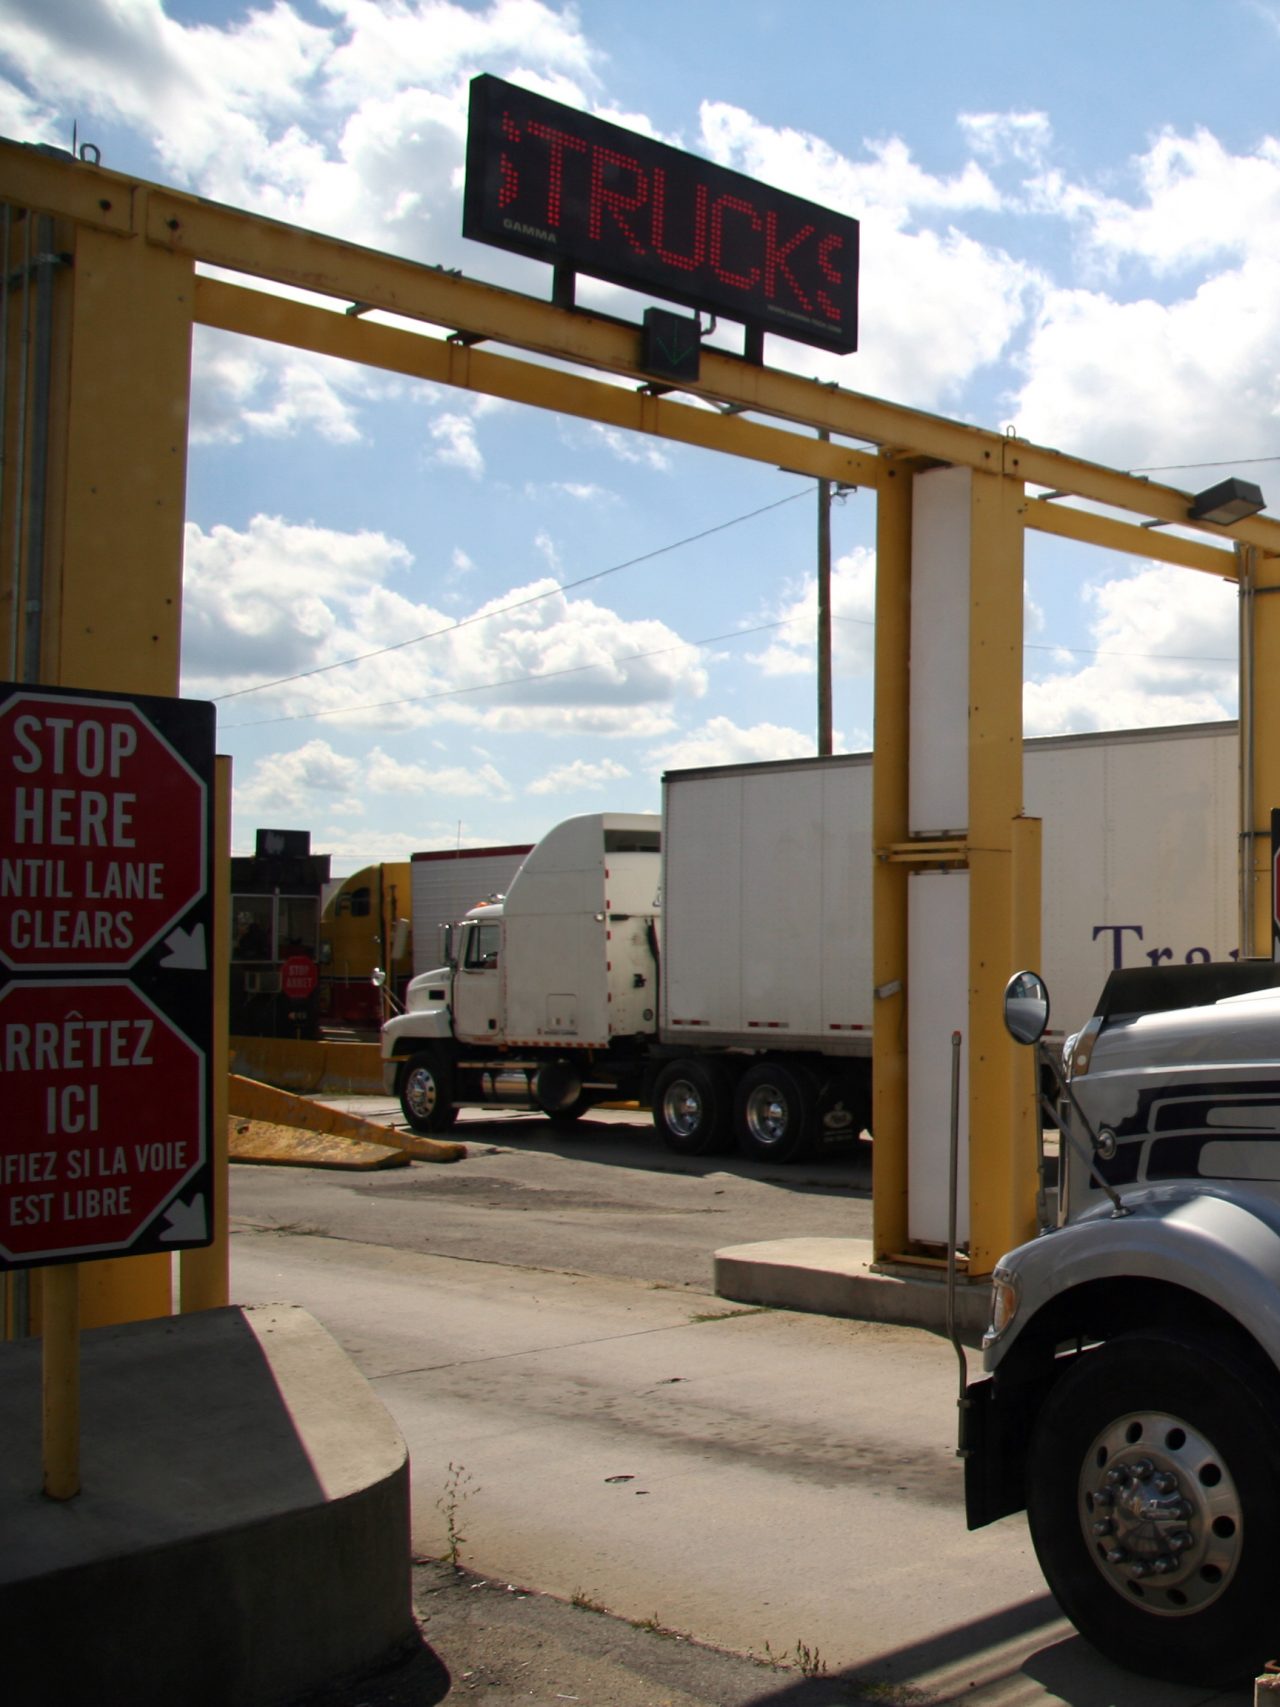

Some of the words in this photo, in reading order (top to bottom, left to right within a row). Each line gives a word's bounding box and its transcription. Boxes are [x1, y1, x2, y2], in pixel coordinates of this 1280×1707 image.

[503, 218, 557, 245] GAMMA
[12, 714, 138, 778] STOP
[14, 786, 137, 848] HERE
[0, 858, 73, 898] NTIL
[85, 860, 165, 900] LANE
[10, 909, 134, 949] CLEARS
[0, 1010, 154, 1072] RRÊTEZ
[47, 1084, 99, 1135] ICI
[0, 1151, 58, 1185] FIEZ
[67, 1149, 91, 1180] SI
[99, 1146, 128, 1176] LA
[134, 1141, 188, 1173] VOIE
[10, 1193, 55, 1227] EST
[63, 1186, 132, 1221] LIBRE
